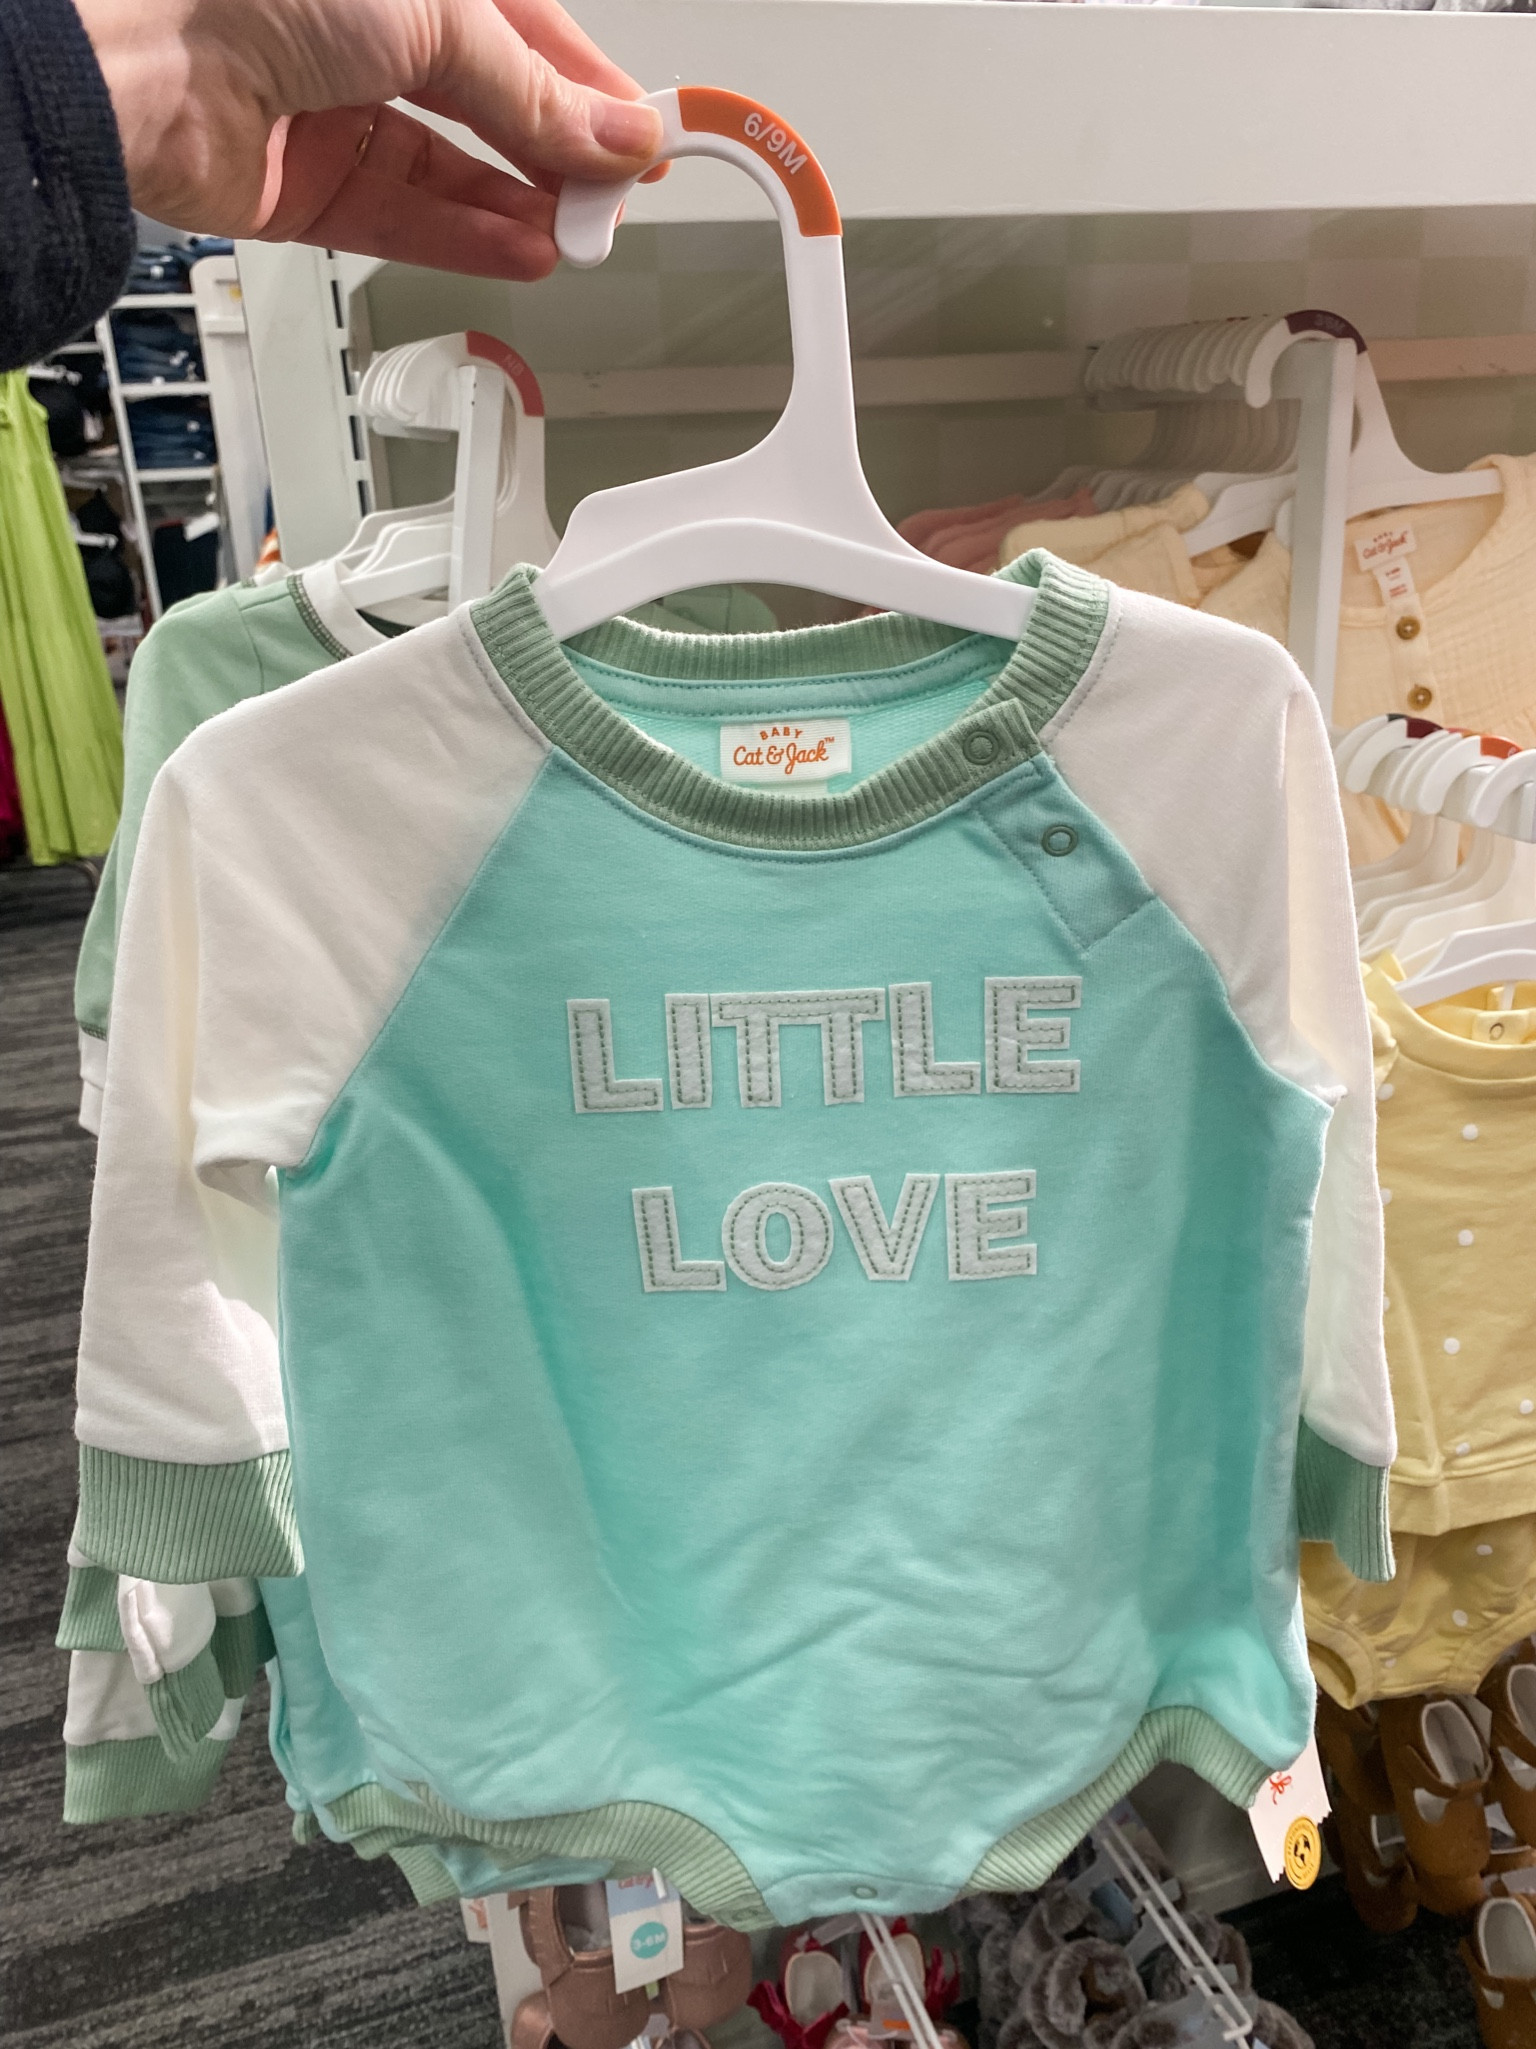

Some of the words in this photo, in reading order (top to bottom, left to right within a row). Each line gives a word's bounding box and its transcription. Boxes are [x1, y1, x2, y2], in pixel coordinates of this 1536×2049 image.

[744, 112, 808, 175] 6/9M
[733, 744, 764, 767] Cat
[766, 745, 785, 765] &
[759, 726, 804, 742] BABY
[566, 975, 1083, 1114] LITTLE
[631, 1168, 1038, 1293] LOVE
